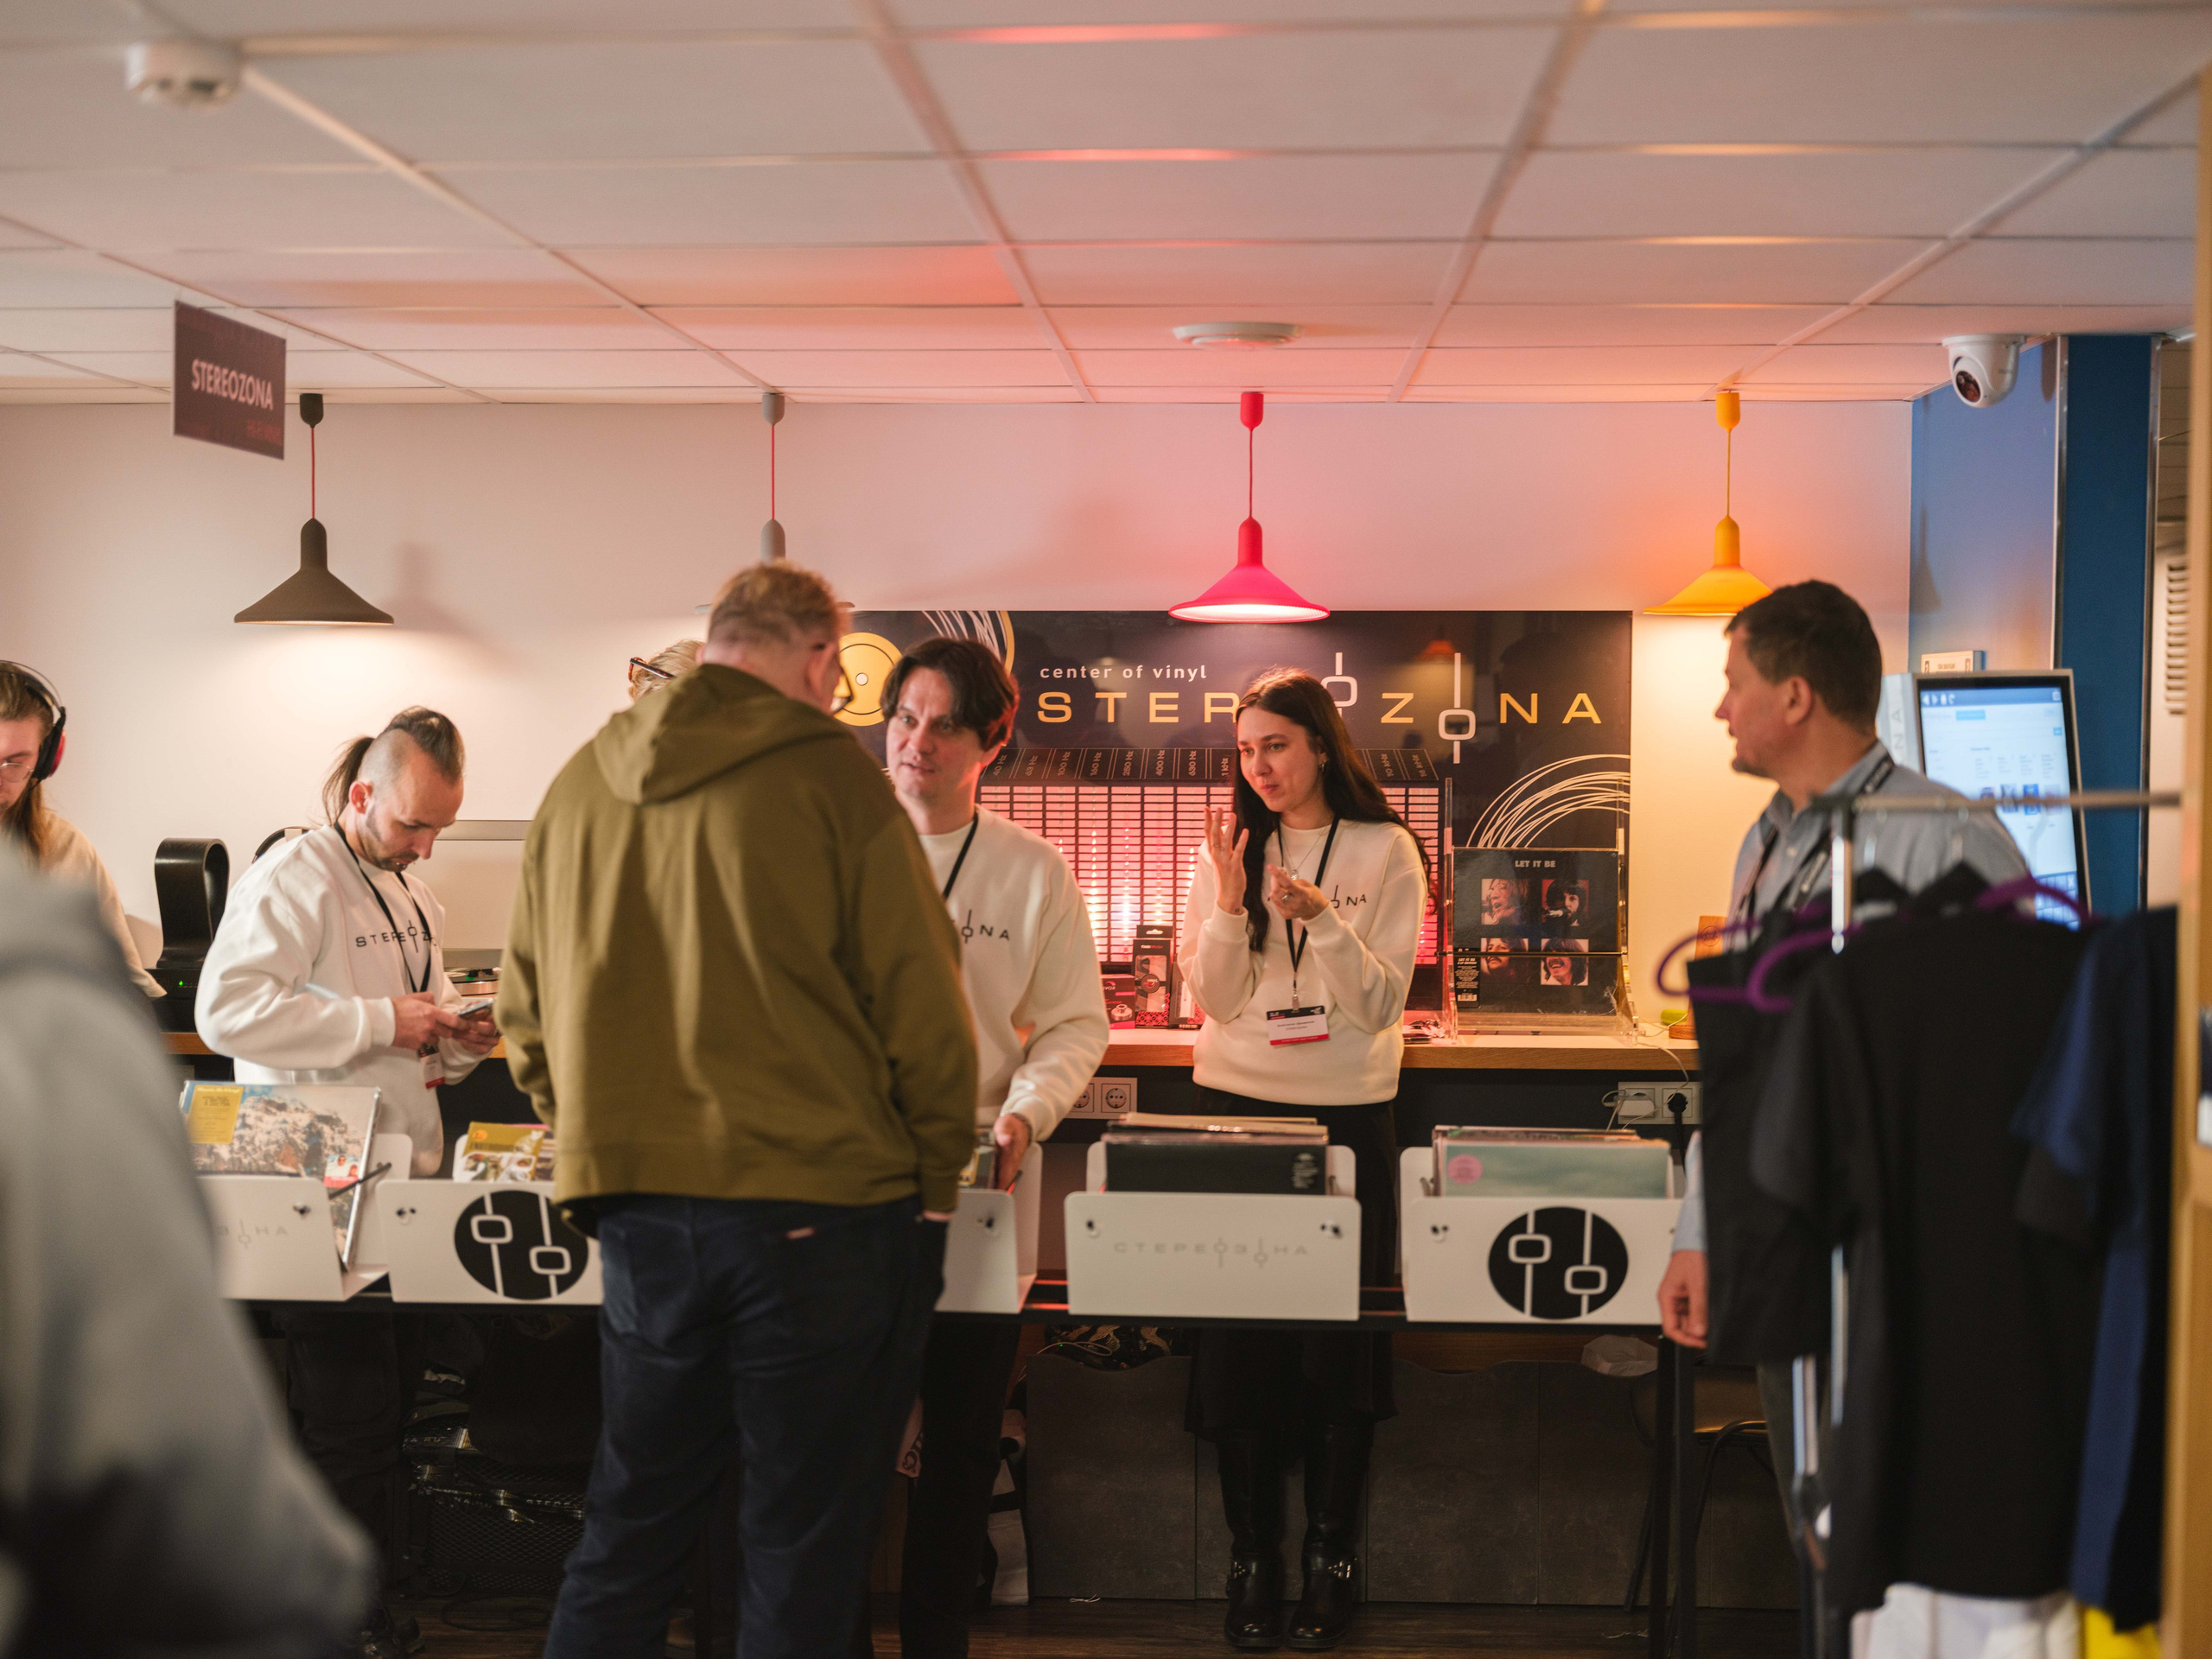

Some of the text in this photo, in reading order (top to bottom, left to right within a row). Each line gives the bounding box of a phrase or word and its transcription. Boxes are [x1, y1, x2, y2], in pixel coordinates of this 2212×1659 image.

[191, 358, 274, 410] STEREOZONA
[1039, 664, 1207, 682] center of vinyl
